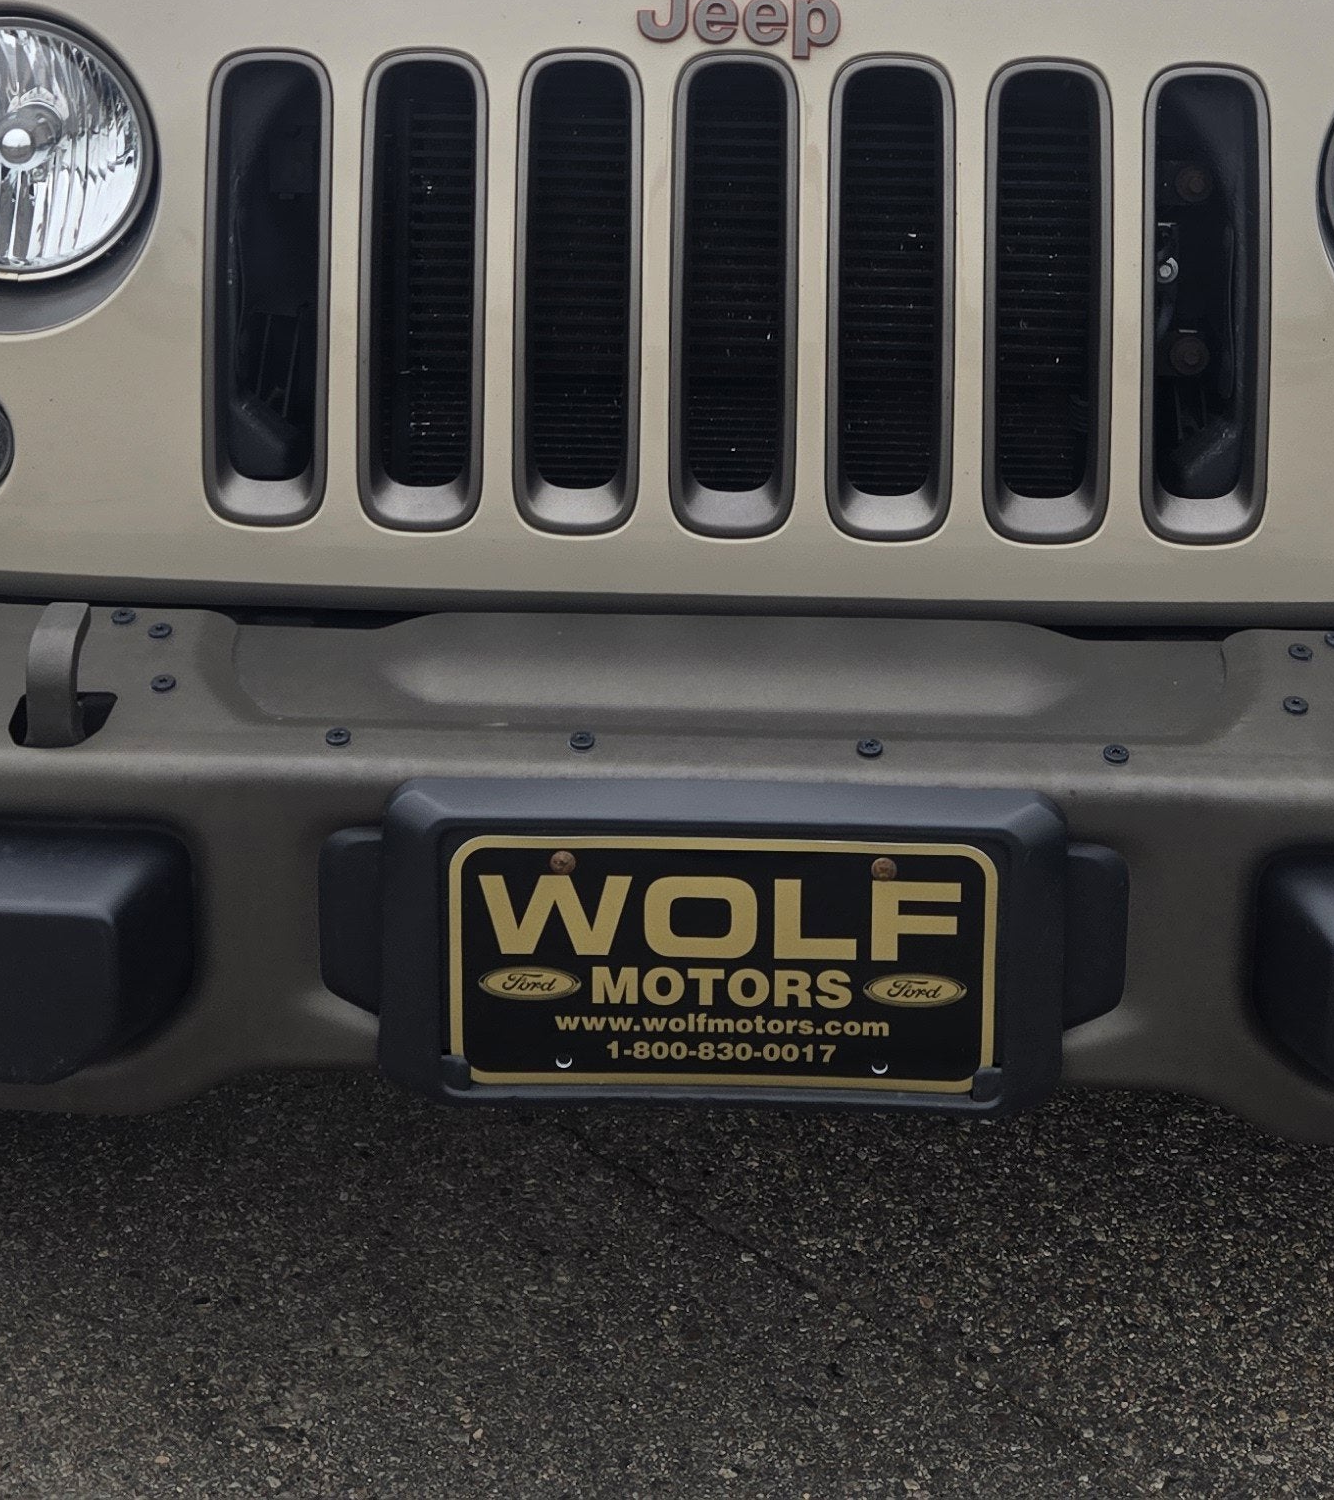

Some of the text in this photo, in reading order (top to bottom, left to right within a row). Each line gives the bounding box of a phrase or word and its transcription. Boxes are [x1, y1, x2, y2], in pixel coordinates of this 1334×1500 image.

[477, 873, 963, 962] WOLF
[501, 965, 943, 1010] Ford MOTORS Ford
[554, 1013, 890, 1037] www.wolfmotors.com
[606, 1040, 837, 1064] 1-800-830-0017
